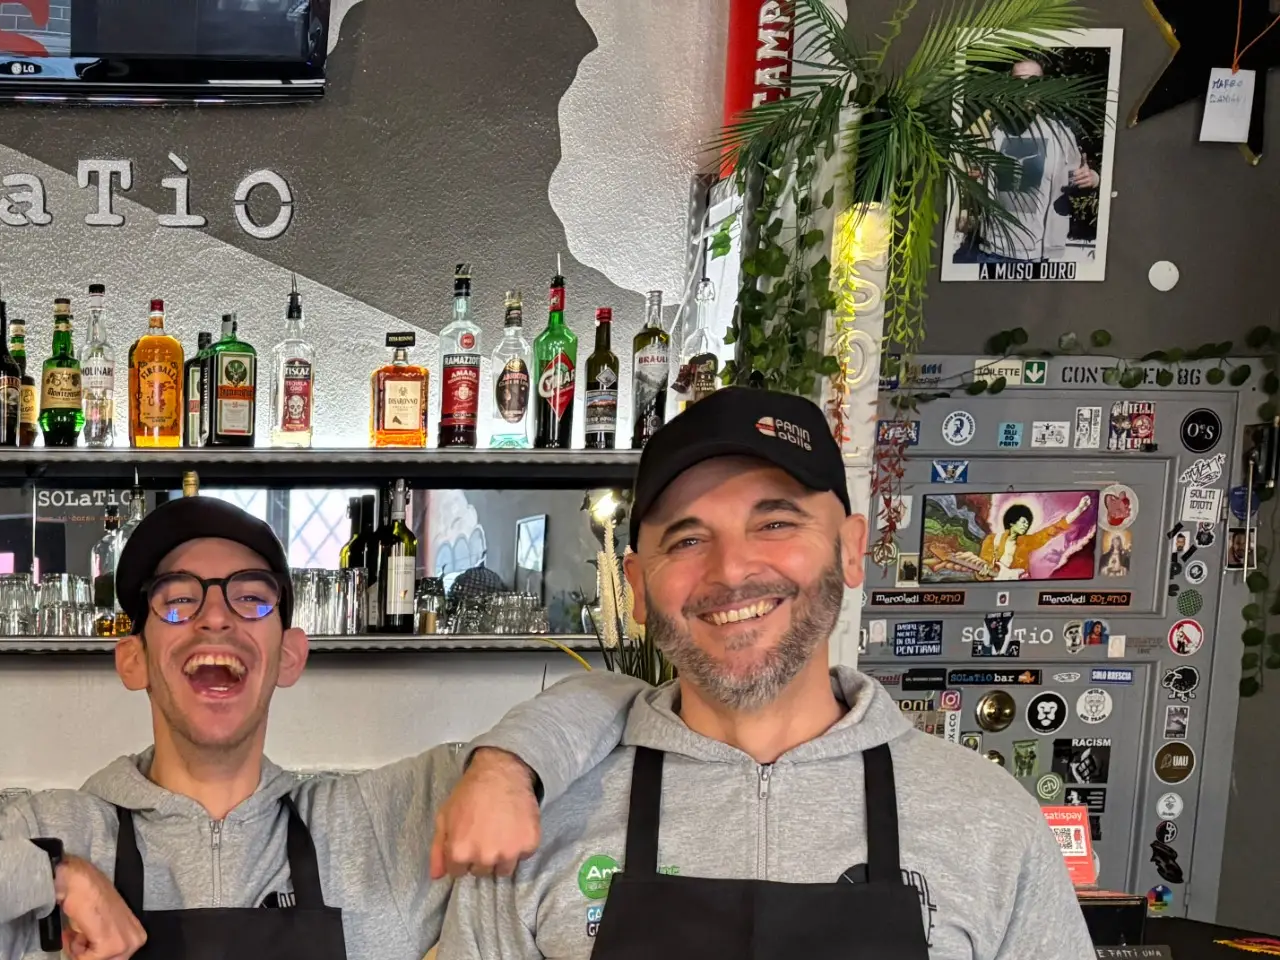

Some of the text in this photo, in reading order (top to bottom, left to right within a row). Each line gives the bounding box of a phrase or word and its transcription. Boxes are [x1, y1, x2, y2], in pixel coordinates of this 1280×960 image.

[22, 64, 35, 73] LG
[980, 262, 1076, 280] A MUSO DURO
[451, 371, 477, 379] AMARO
[977, 367, 1021, 376] TOILETTE
[1177, 368, 1201, 386] 86
[388, 397, 418, 405] DISARONNO
[775, 419, 810, 442] PANIN
[778, 431, 812, 451] abile
[1189, 489, 1216, 500] SOLITI
[1189, 501, 1213, 511] IDIOTI
[993, 672, 1014, 682] bar
[1092, 671, 1132, 681] SOLO BRESCIA
[1071, 738, 1111, 747] RACISM
[1172, 755, 1188, 766] UAU
[1044, 810, 1083, 822] satispay
[1142, 949, 1162, 957] UNA
